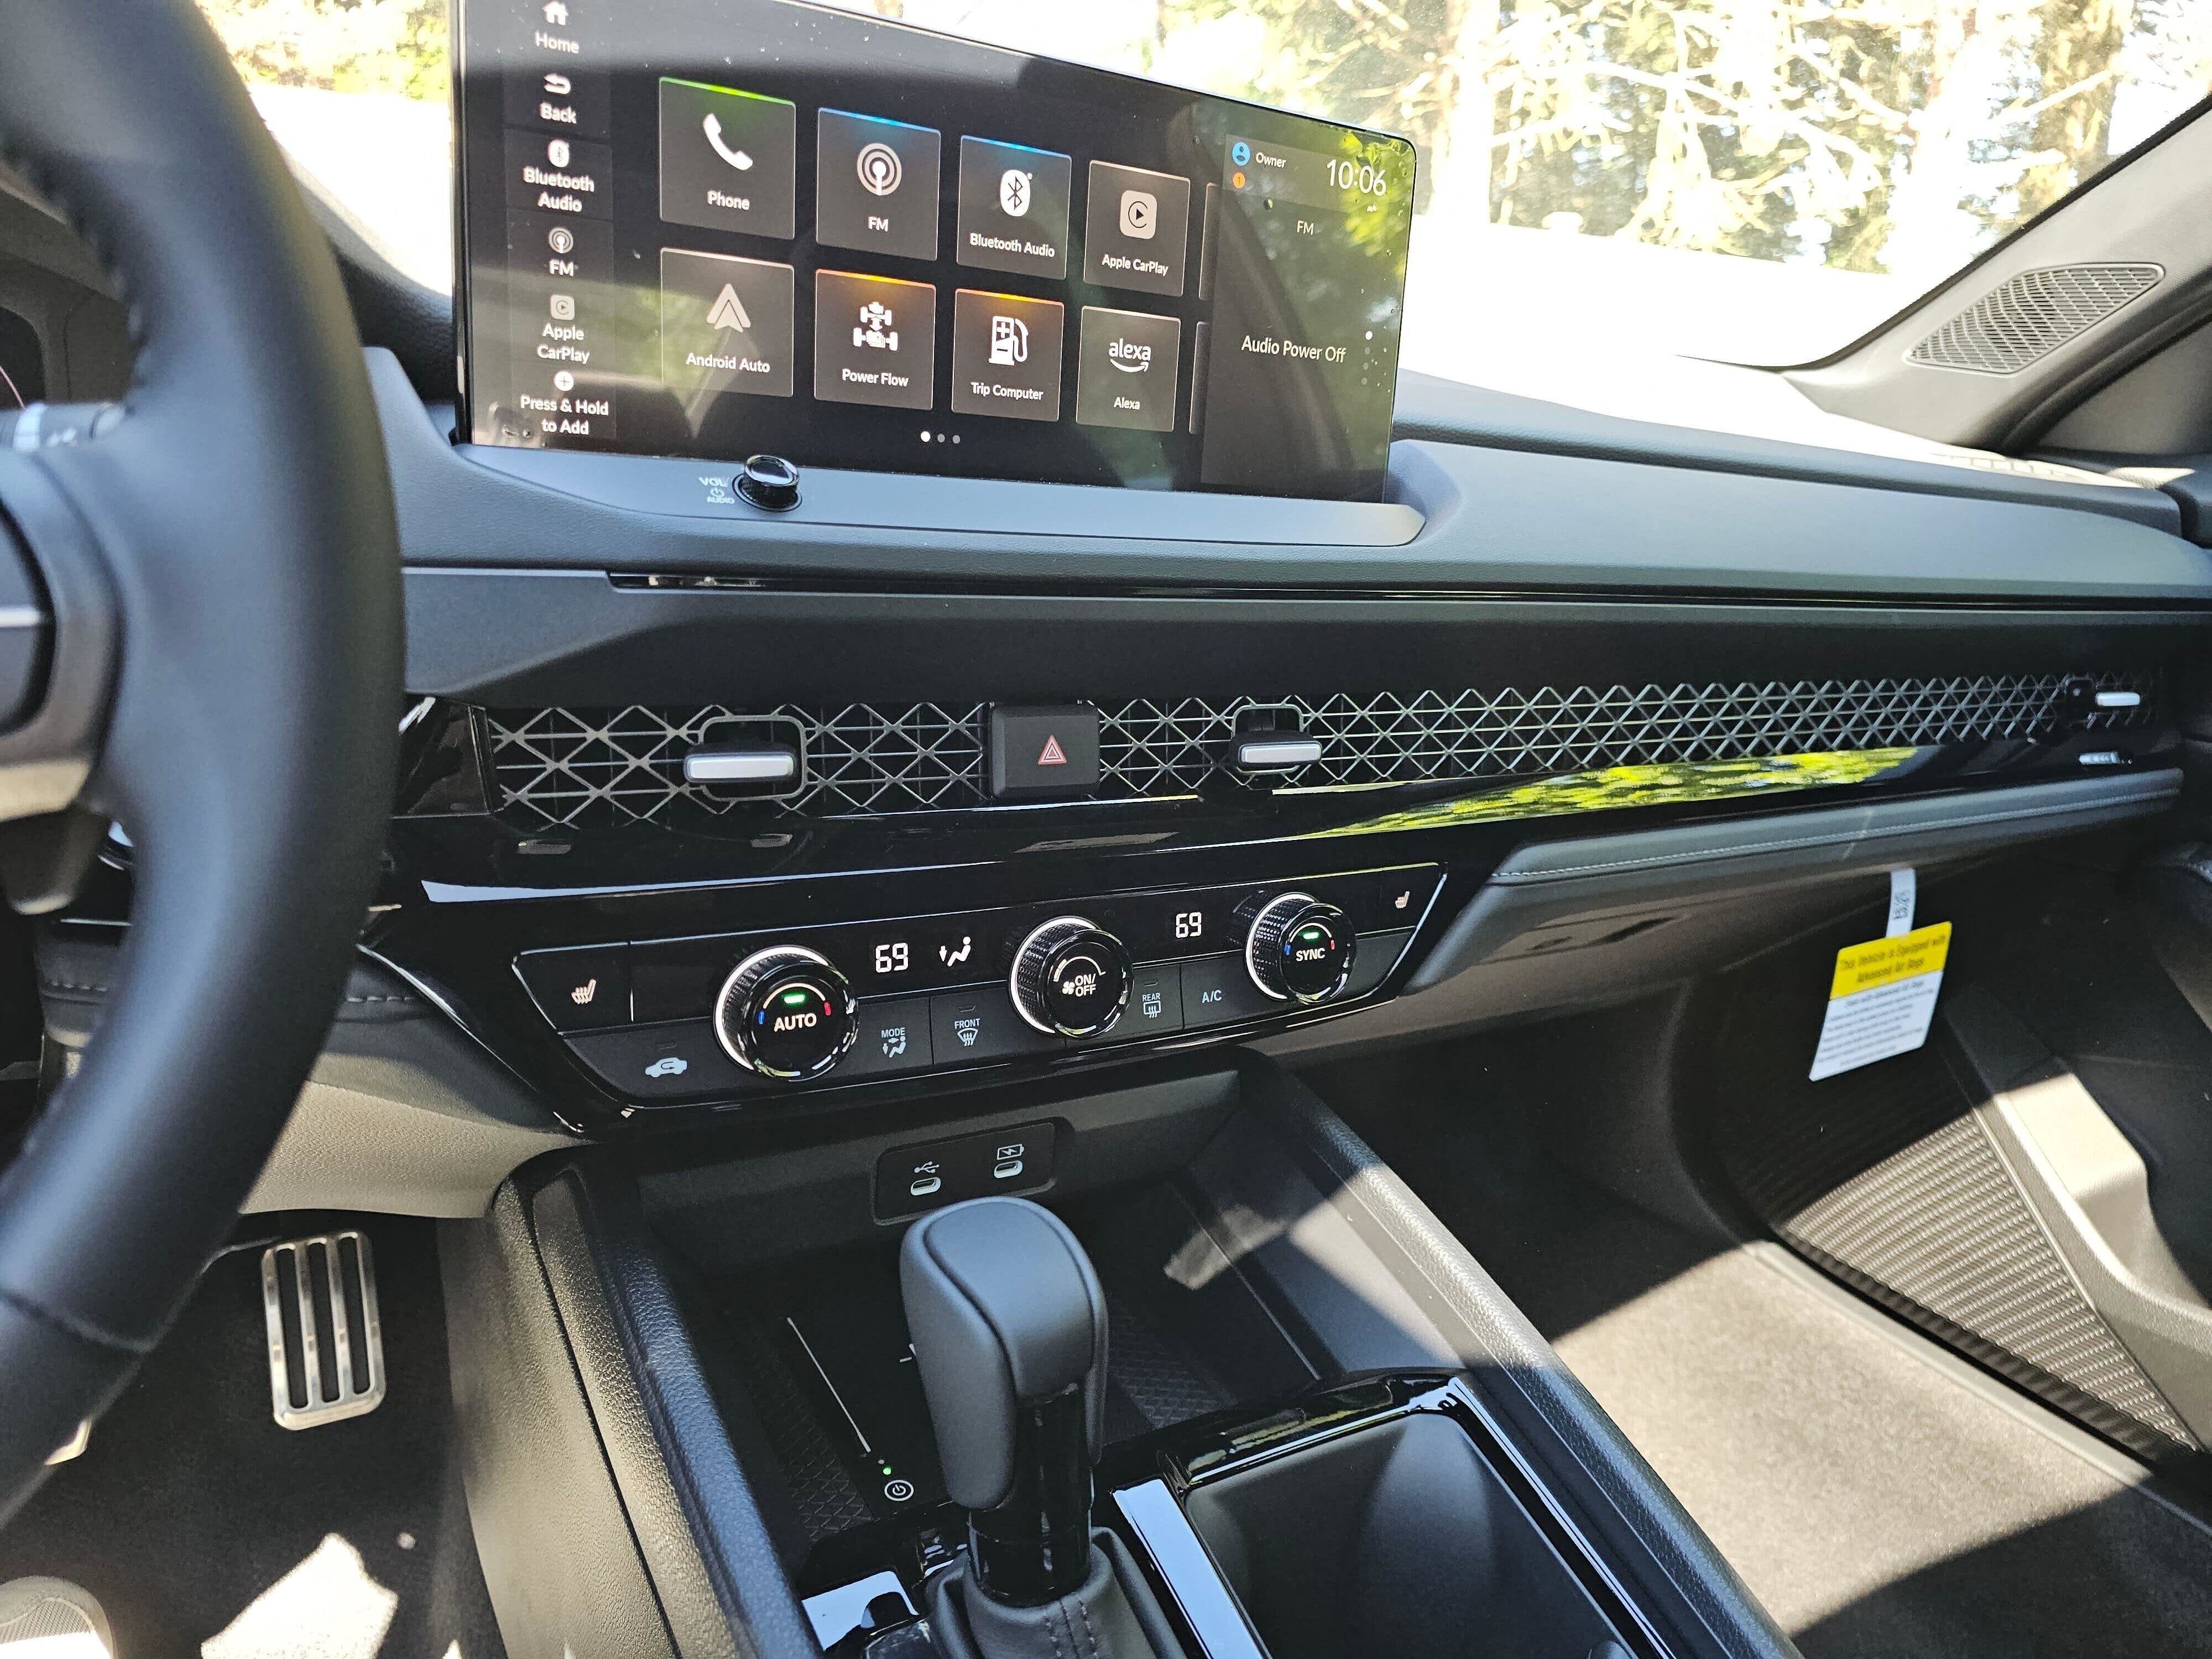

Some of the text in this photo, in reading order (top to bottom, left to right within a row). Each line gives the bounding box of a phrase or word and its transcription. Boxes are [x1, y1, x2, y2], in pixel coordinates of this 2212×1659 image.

[535, 32, 580, 54] Home
[540, 102, 577, 124] Back
[1255, 152, 1287, 168] Owner
[523, 166, 594, 192] Bluetooth
[1327, 159, 1386, 196] 10:06
[538, 191, 582, 212] Audio
[707, 190, 750, 210] Phone
[868, 216, 889, 232] FM
[1297, 220, 1314, 236] FM
[969, 232, 1055, 258] Bluetooth Audio
[549, 259, 574, 276] FM
[1102, 254, 1169, 276] Apple CarPlay
[541, 322, 585, 341] Apple
[537, 345, 590, 364] CarPlay
[1108, 338, 1151, 362] alexa
[1241, 335, 1347, 363] Audio Power Off
[686, 352, 770, 373] Android Auto
[842, 368, 909, 387] Power Flow
[971, 382, 1044, 400] Trip Computer
[520, 394, 609, 416] Press & Hold
[1113, 397, 1140, 410] Alexa
[541, 418, 589, 435] to Add
[1176, 911, 1202, 938] 69
[875, 942, 909, 973] 69
[1296, 947, 1326, 962] SYNC
[1074, 973, 1097, 987] ON/
[1075, 983, 1097, 997] OFF
[1142, 993, 1161, 1003] REAR
[1202, 989, 1222, 1004] A/C
[774, 1013, 817, 1032] AUTO
[954, 1018, 980, 1030] FRONT
[881, 1027, 906, 1039] MODE
